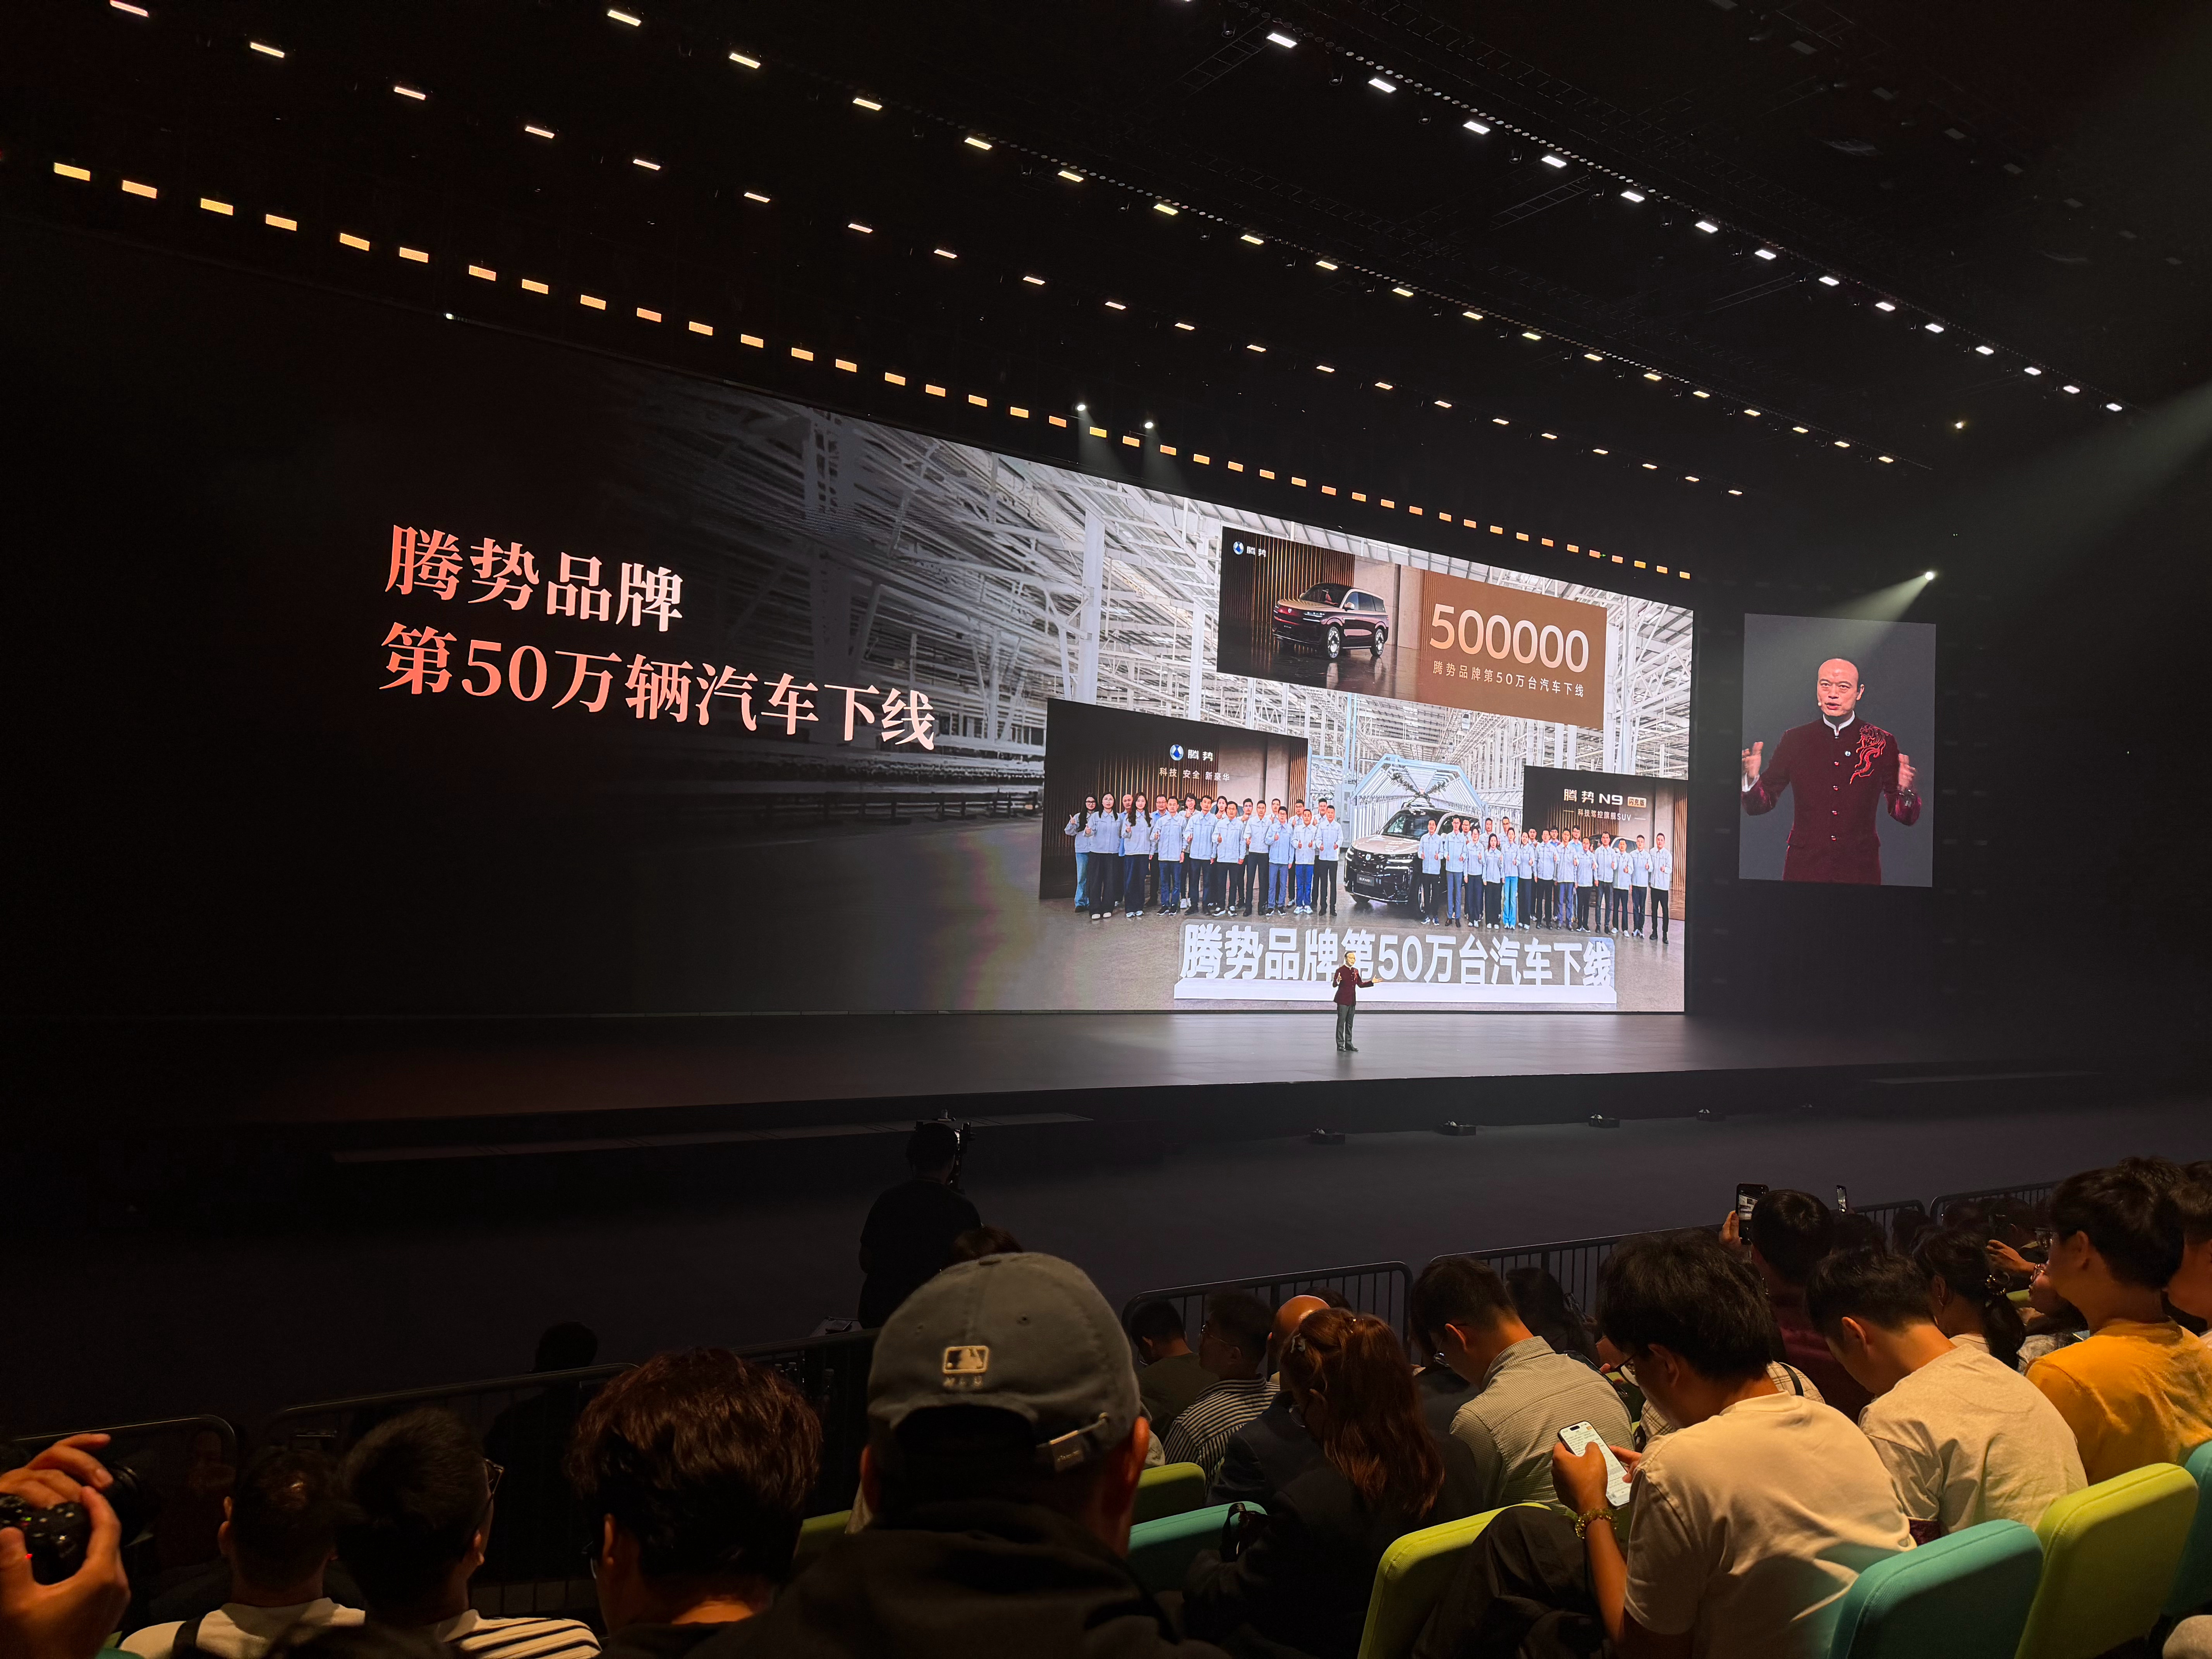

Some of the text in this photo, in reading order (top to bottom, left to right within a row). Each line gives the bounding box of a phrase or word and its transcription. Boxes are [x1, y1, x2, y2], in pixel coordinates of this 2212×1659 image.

[385, 525, 683, 632] 腾势品牌
[1430, 603, 1589, 673] 500000
[380, 622, 935, 750] 第50万辆汽车下线
[1433, 660, 1584, 697] 腾势品牌第50万台汽车下线
[1159, 767, 1177, 777] 科技
[1183, 769, 1200, 780] 安全
[1599, 793, 1623, 805] N9
